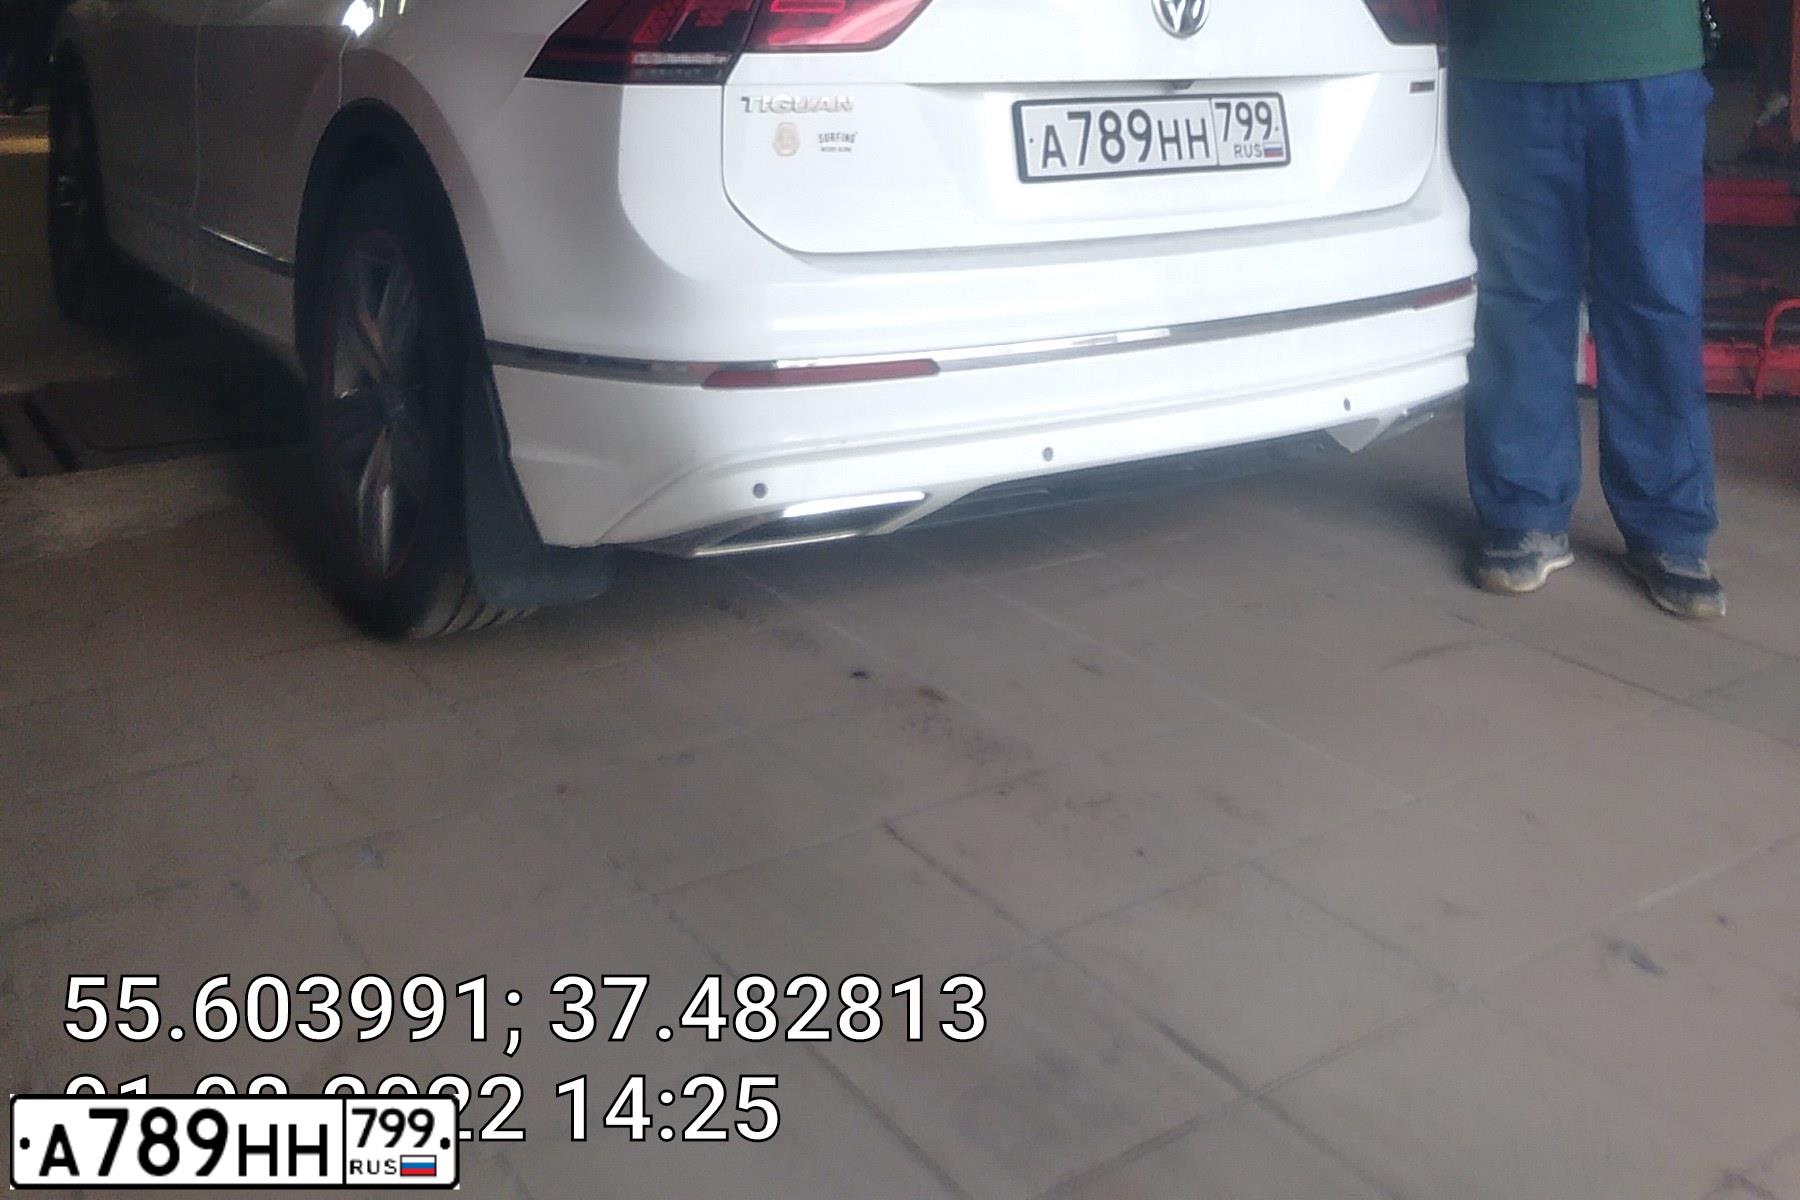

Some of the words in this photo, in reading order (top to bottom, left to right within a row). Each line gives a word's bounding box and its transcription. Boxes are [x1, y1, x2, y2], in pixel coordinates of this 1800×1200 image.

[741, 95, 854, 114] TIGUAN
[1215, 101, 1273, 142] 799
[1233, 143, 1263, 159] RUS
